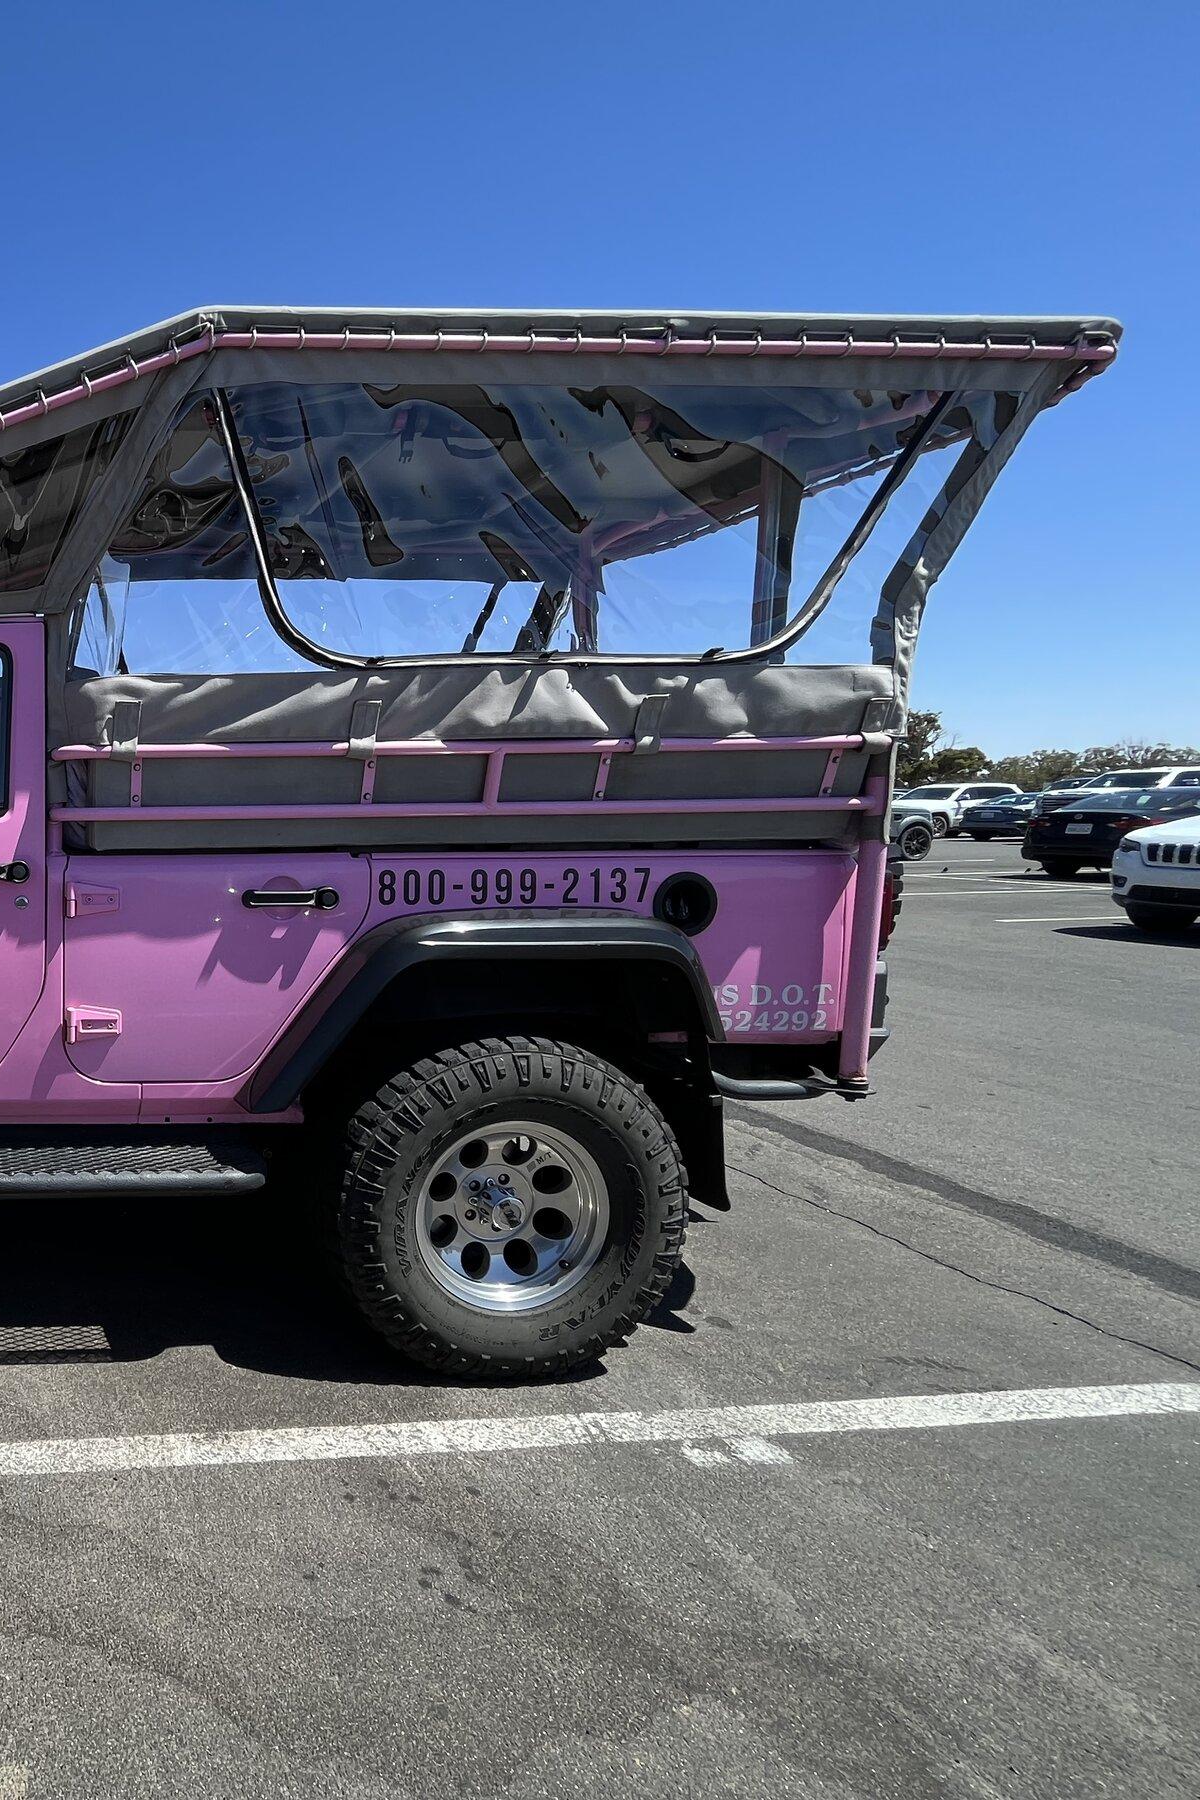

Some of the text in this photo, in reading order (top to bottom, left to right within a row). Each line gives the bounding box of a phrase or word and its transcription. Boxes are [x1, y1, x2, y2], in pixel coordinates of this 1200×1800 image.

[377, 867, 651, 906] 800-999-2137
[749, 983, 835, 1006] D.O.T.
[718, 1009, 828, 1032] 524292
